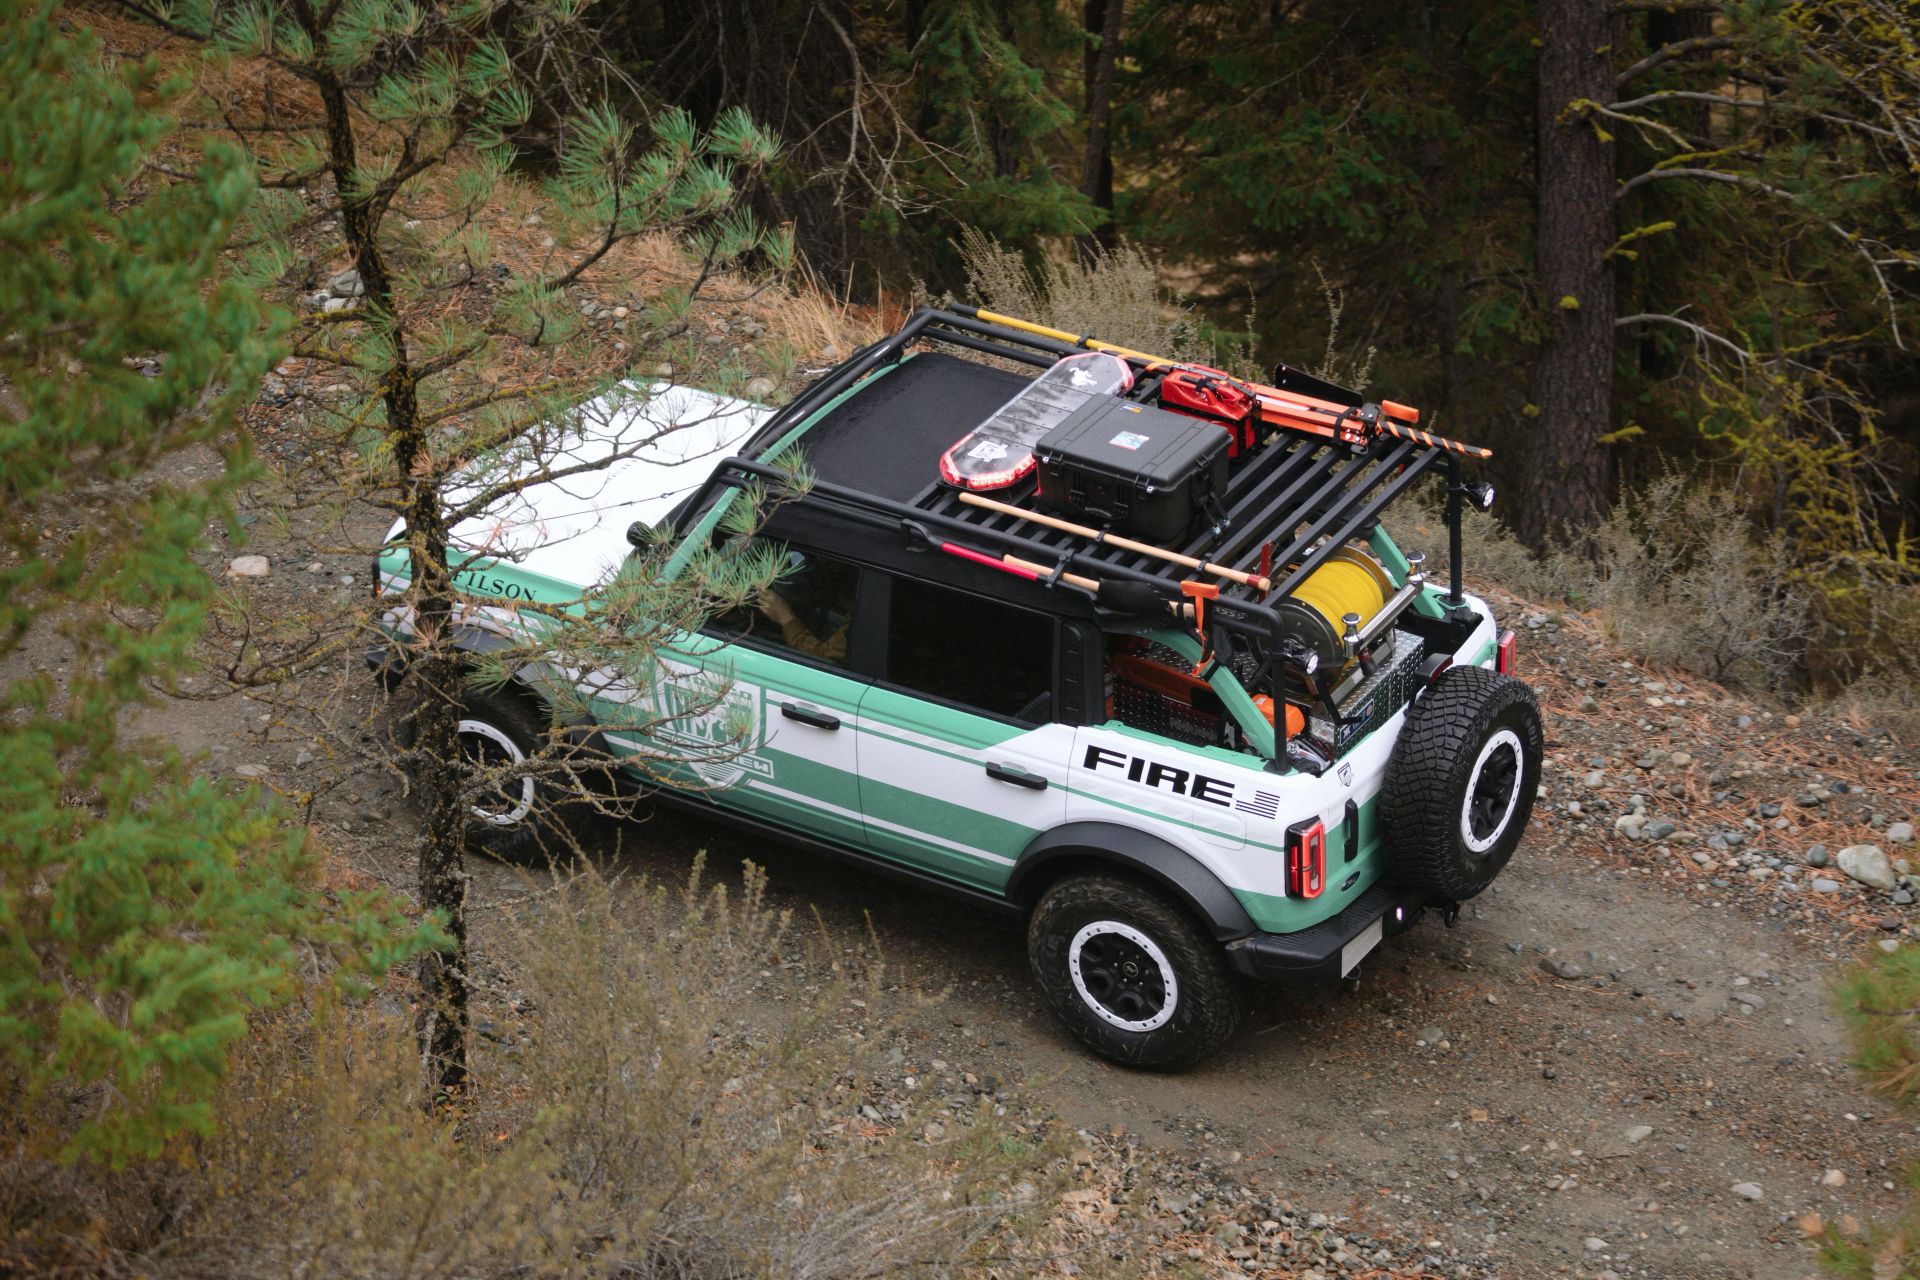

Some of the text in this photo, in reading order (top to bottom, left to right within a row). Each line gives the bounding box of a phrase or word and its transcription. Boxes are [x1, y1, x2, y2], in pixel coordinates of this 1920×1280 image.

[452, 569, 538, 601] FILSON
[707, 747, 770, 773] CEW
[1083, 744, 1236, 808] FIRE
